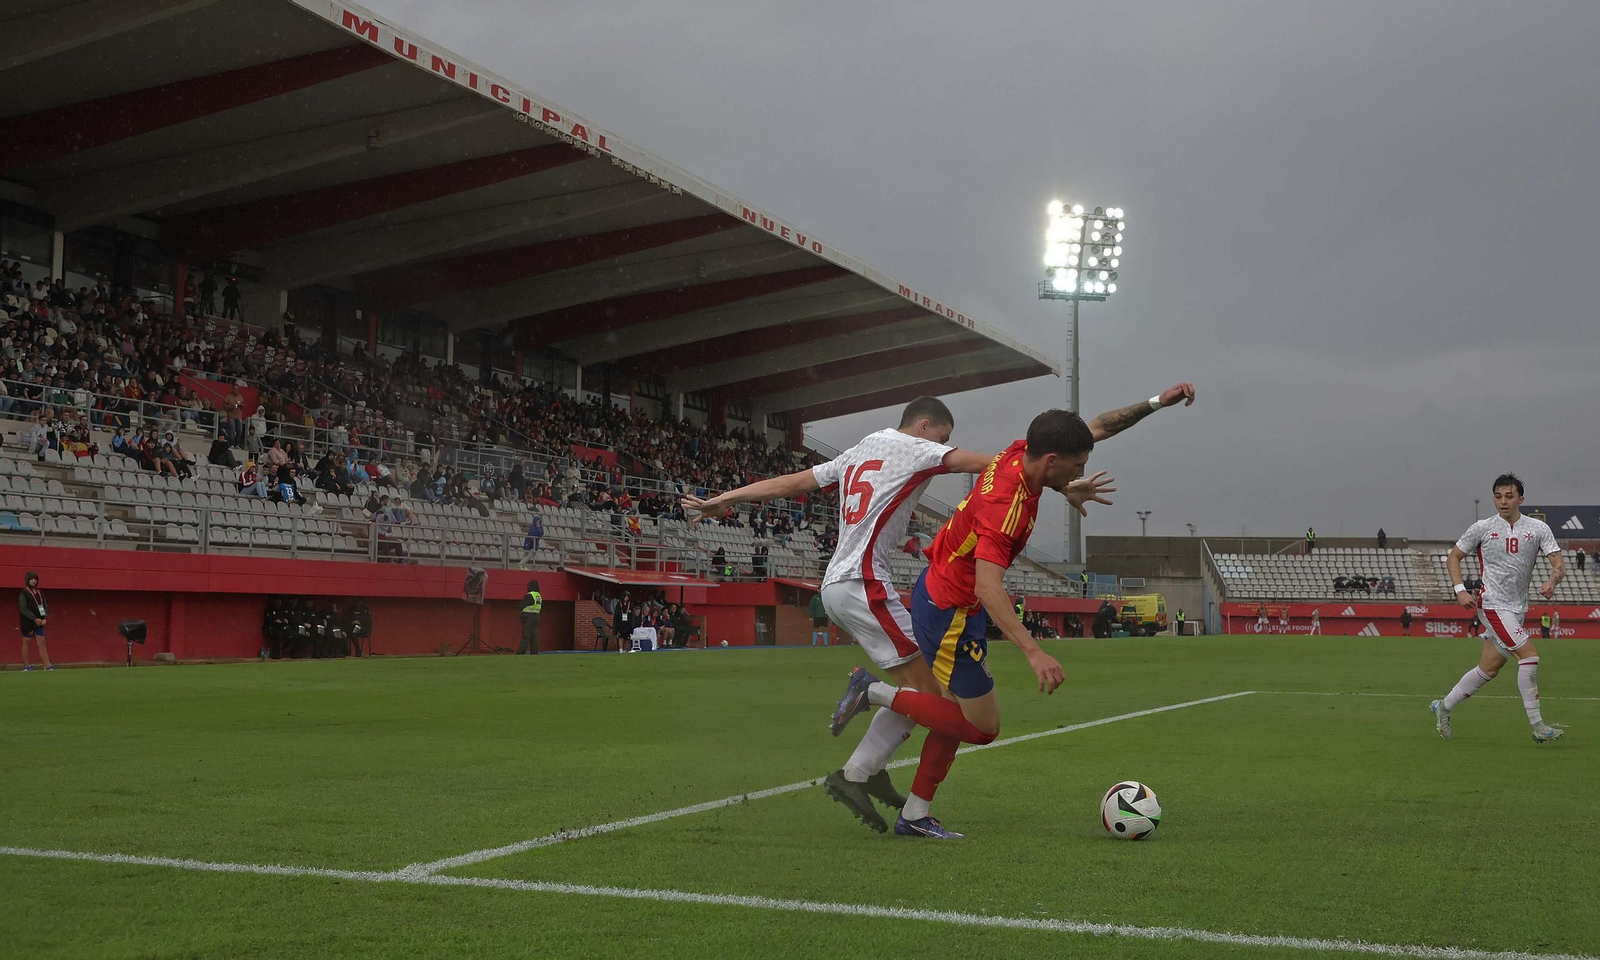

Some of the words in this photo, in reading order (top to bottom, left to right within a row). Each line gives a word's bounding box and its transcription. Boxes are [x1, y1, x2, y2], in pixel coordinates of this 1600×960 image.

[342, 9, 612, 153] MUNICIPAL
[743, 207, 823, 254] NUEVO
[898, 284, 975, 330] MIRADOR
[842, 459, 884, 525] 15
[1505, 537, 1519, 554] 18
